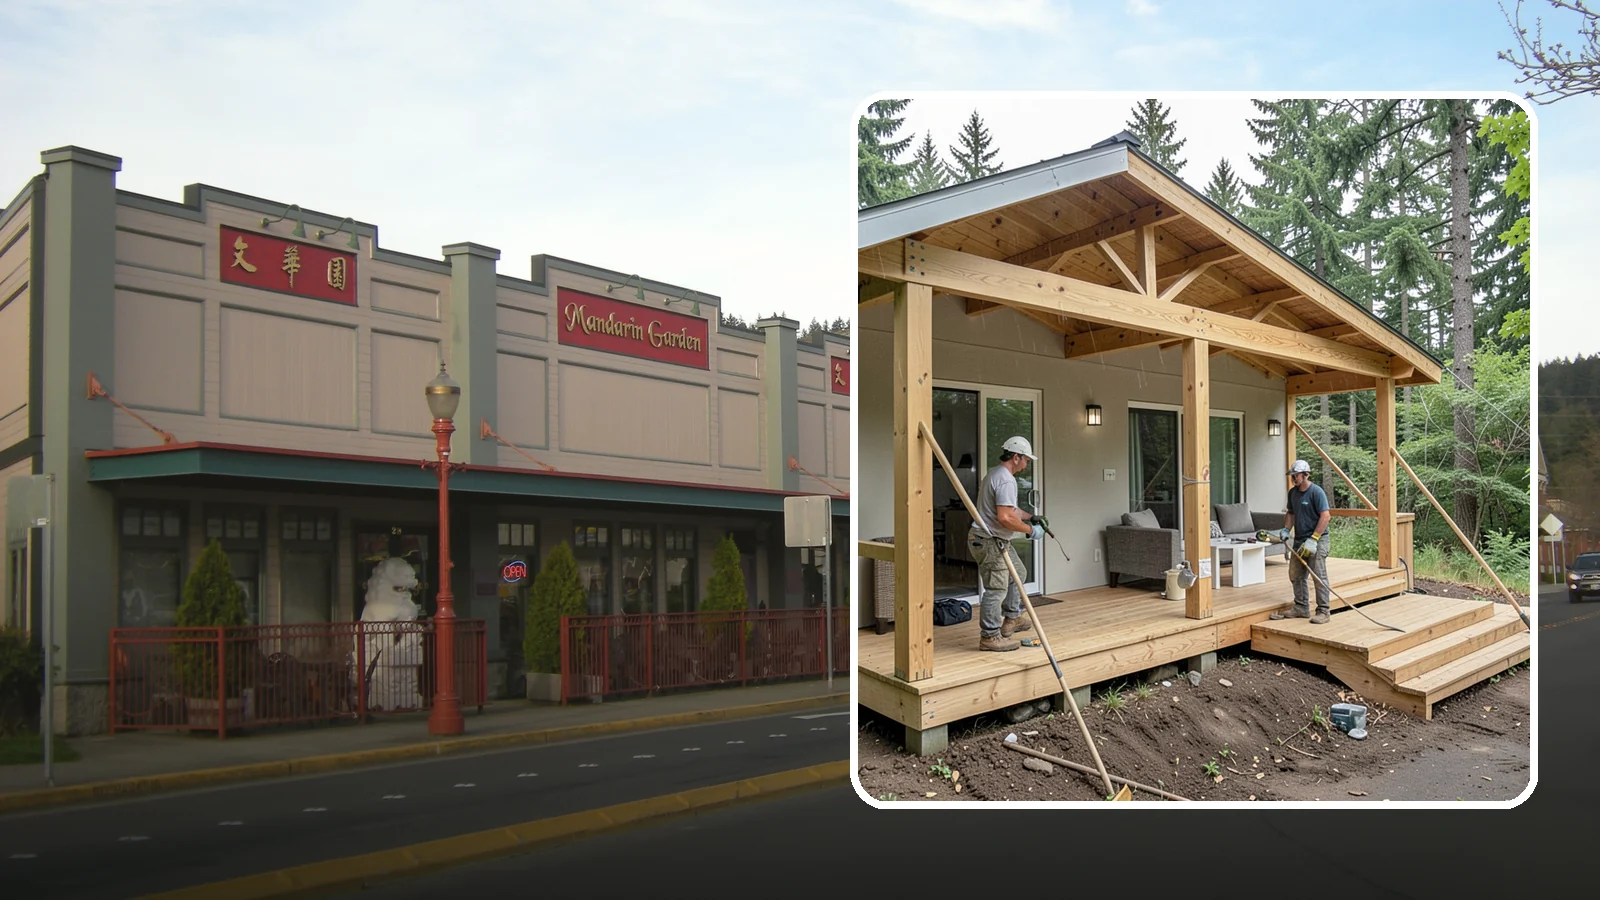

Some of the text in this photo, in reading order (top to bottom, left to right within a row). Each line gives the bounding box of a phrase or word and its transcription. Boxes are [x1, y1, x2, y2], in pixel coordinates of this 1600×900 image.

[230, 235, 347, 292] 文華園
[564, 302, 702, 353] Mandarin Garden
[834, 363, 847, 387] 文
[503, 565, 527, 578] OPEN
